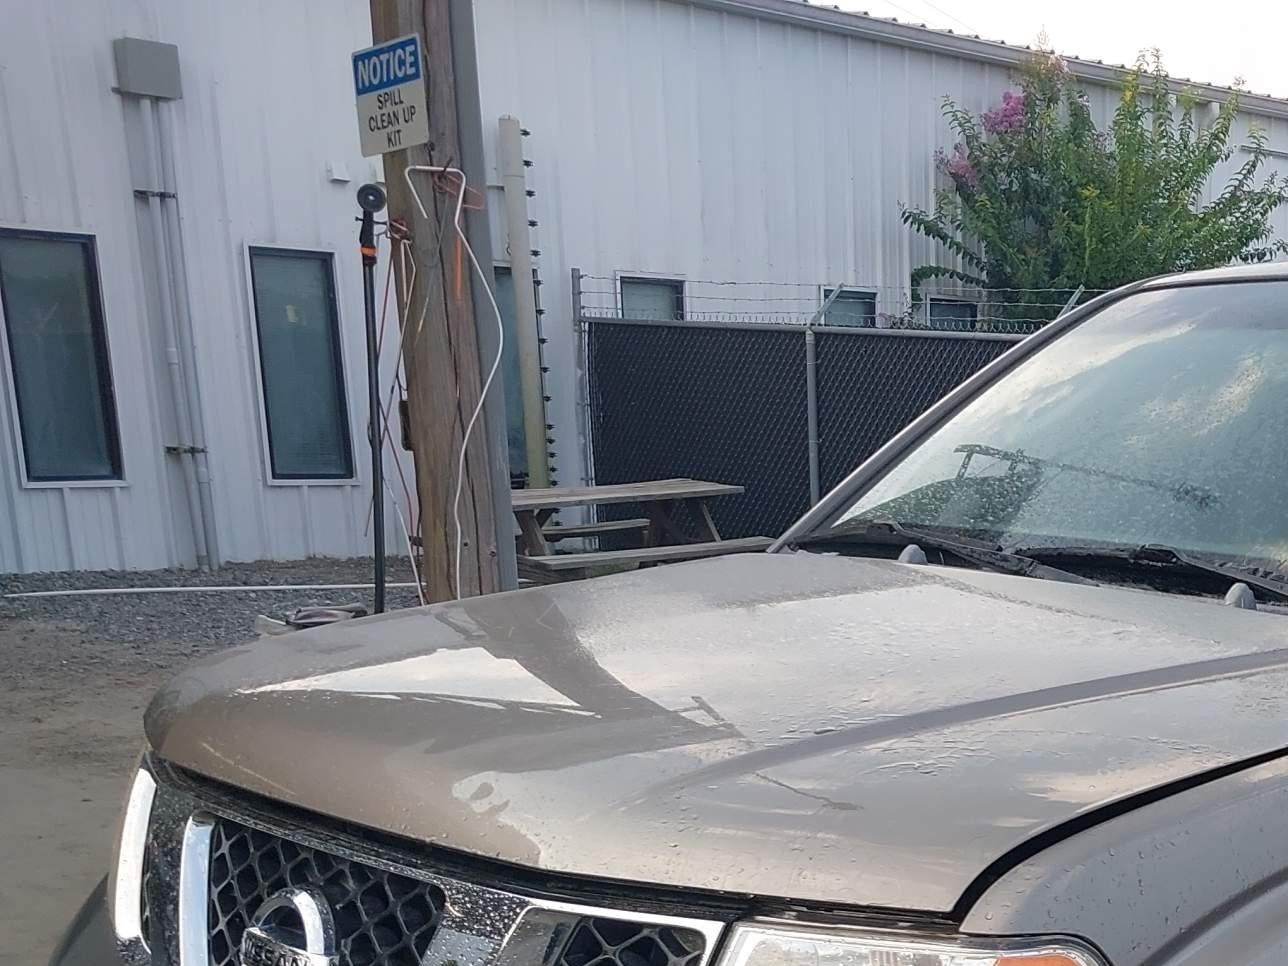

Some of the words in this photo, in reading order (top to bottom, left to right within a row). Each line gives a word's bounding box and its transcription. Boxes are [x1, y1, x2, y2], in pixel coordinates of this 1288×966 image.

[358, 45, 416, 89] NOTICE
[377, 89, 404, 110] SPILL
[368, 110, 400, 132] CLEAN
[403, 105, 416, 124] UP
[387, 130, 402, 148] KIT
